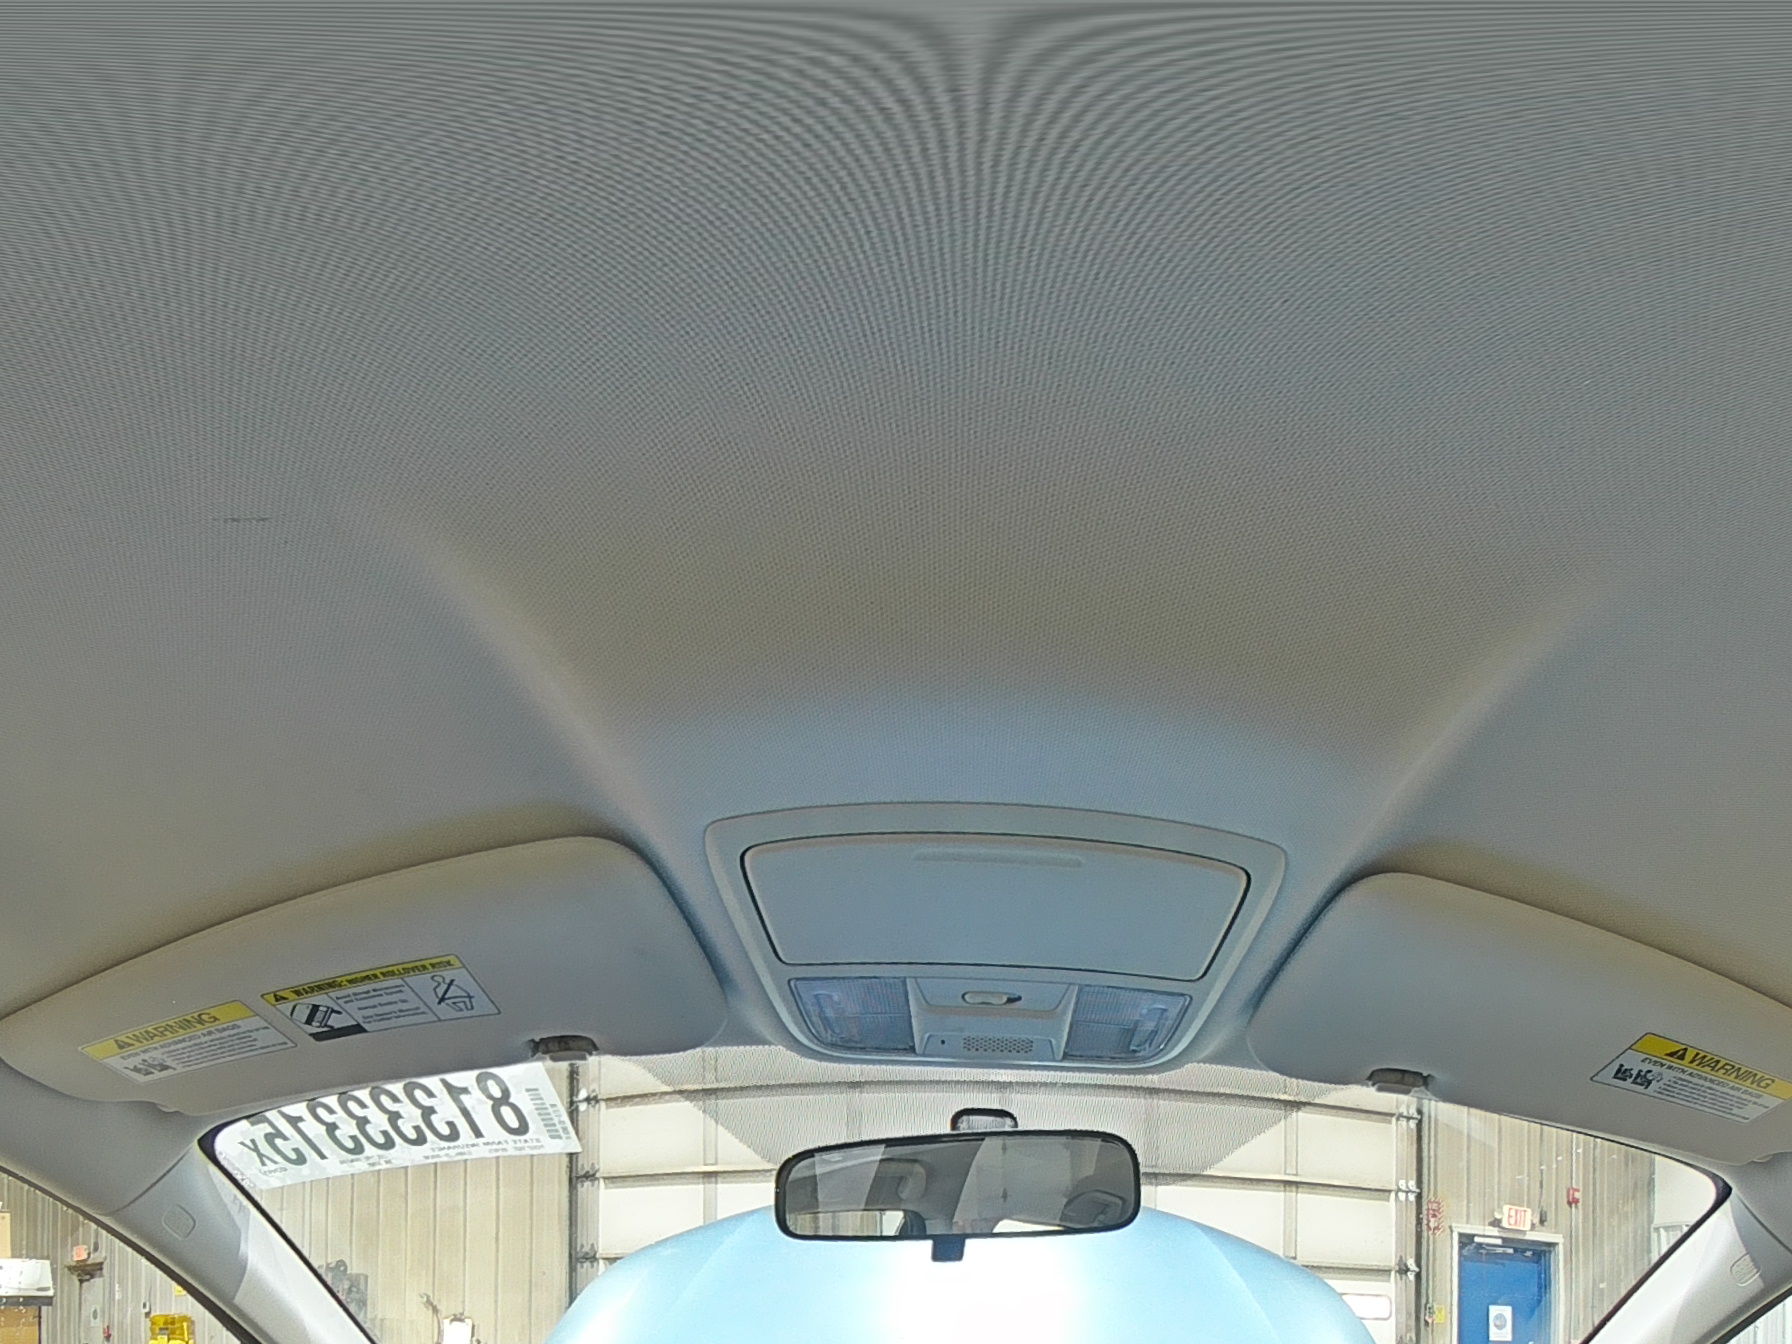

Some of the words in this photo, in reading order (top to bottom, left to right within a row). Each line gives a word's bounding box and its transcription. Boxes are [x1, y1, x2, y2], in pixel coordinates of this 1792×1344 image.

[126, 1012, 220, 1045] WARNING
[1688, 1052, 1776, 1090] WARNING
[1508, 1207, 1528, 1228] EXIT
